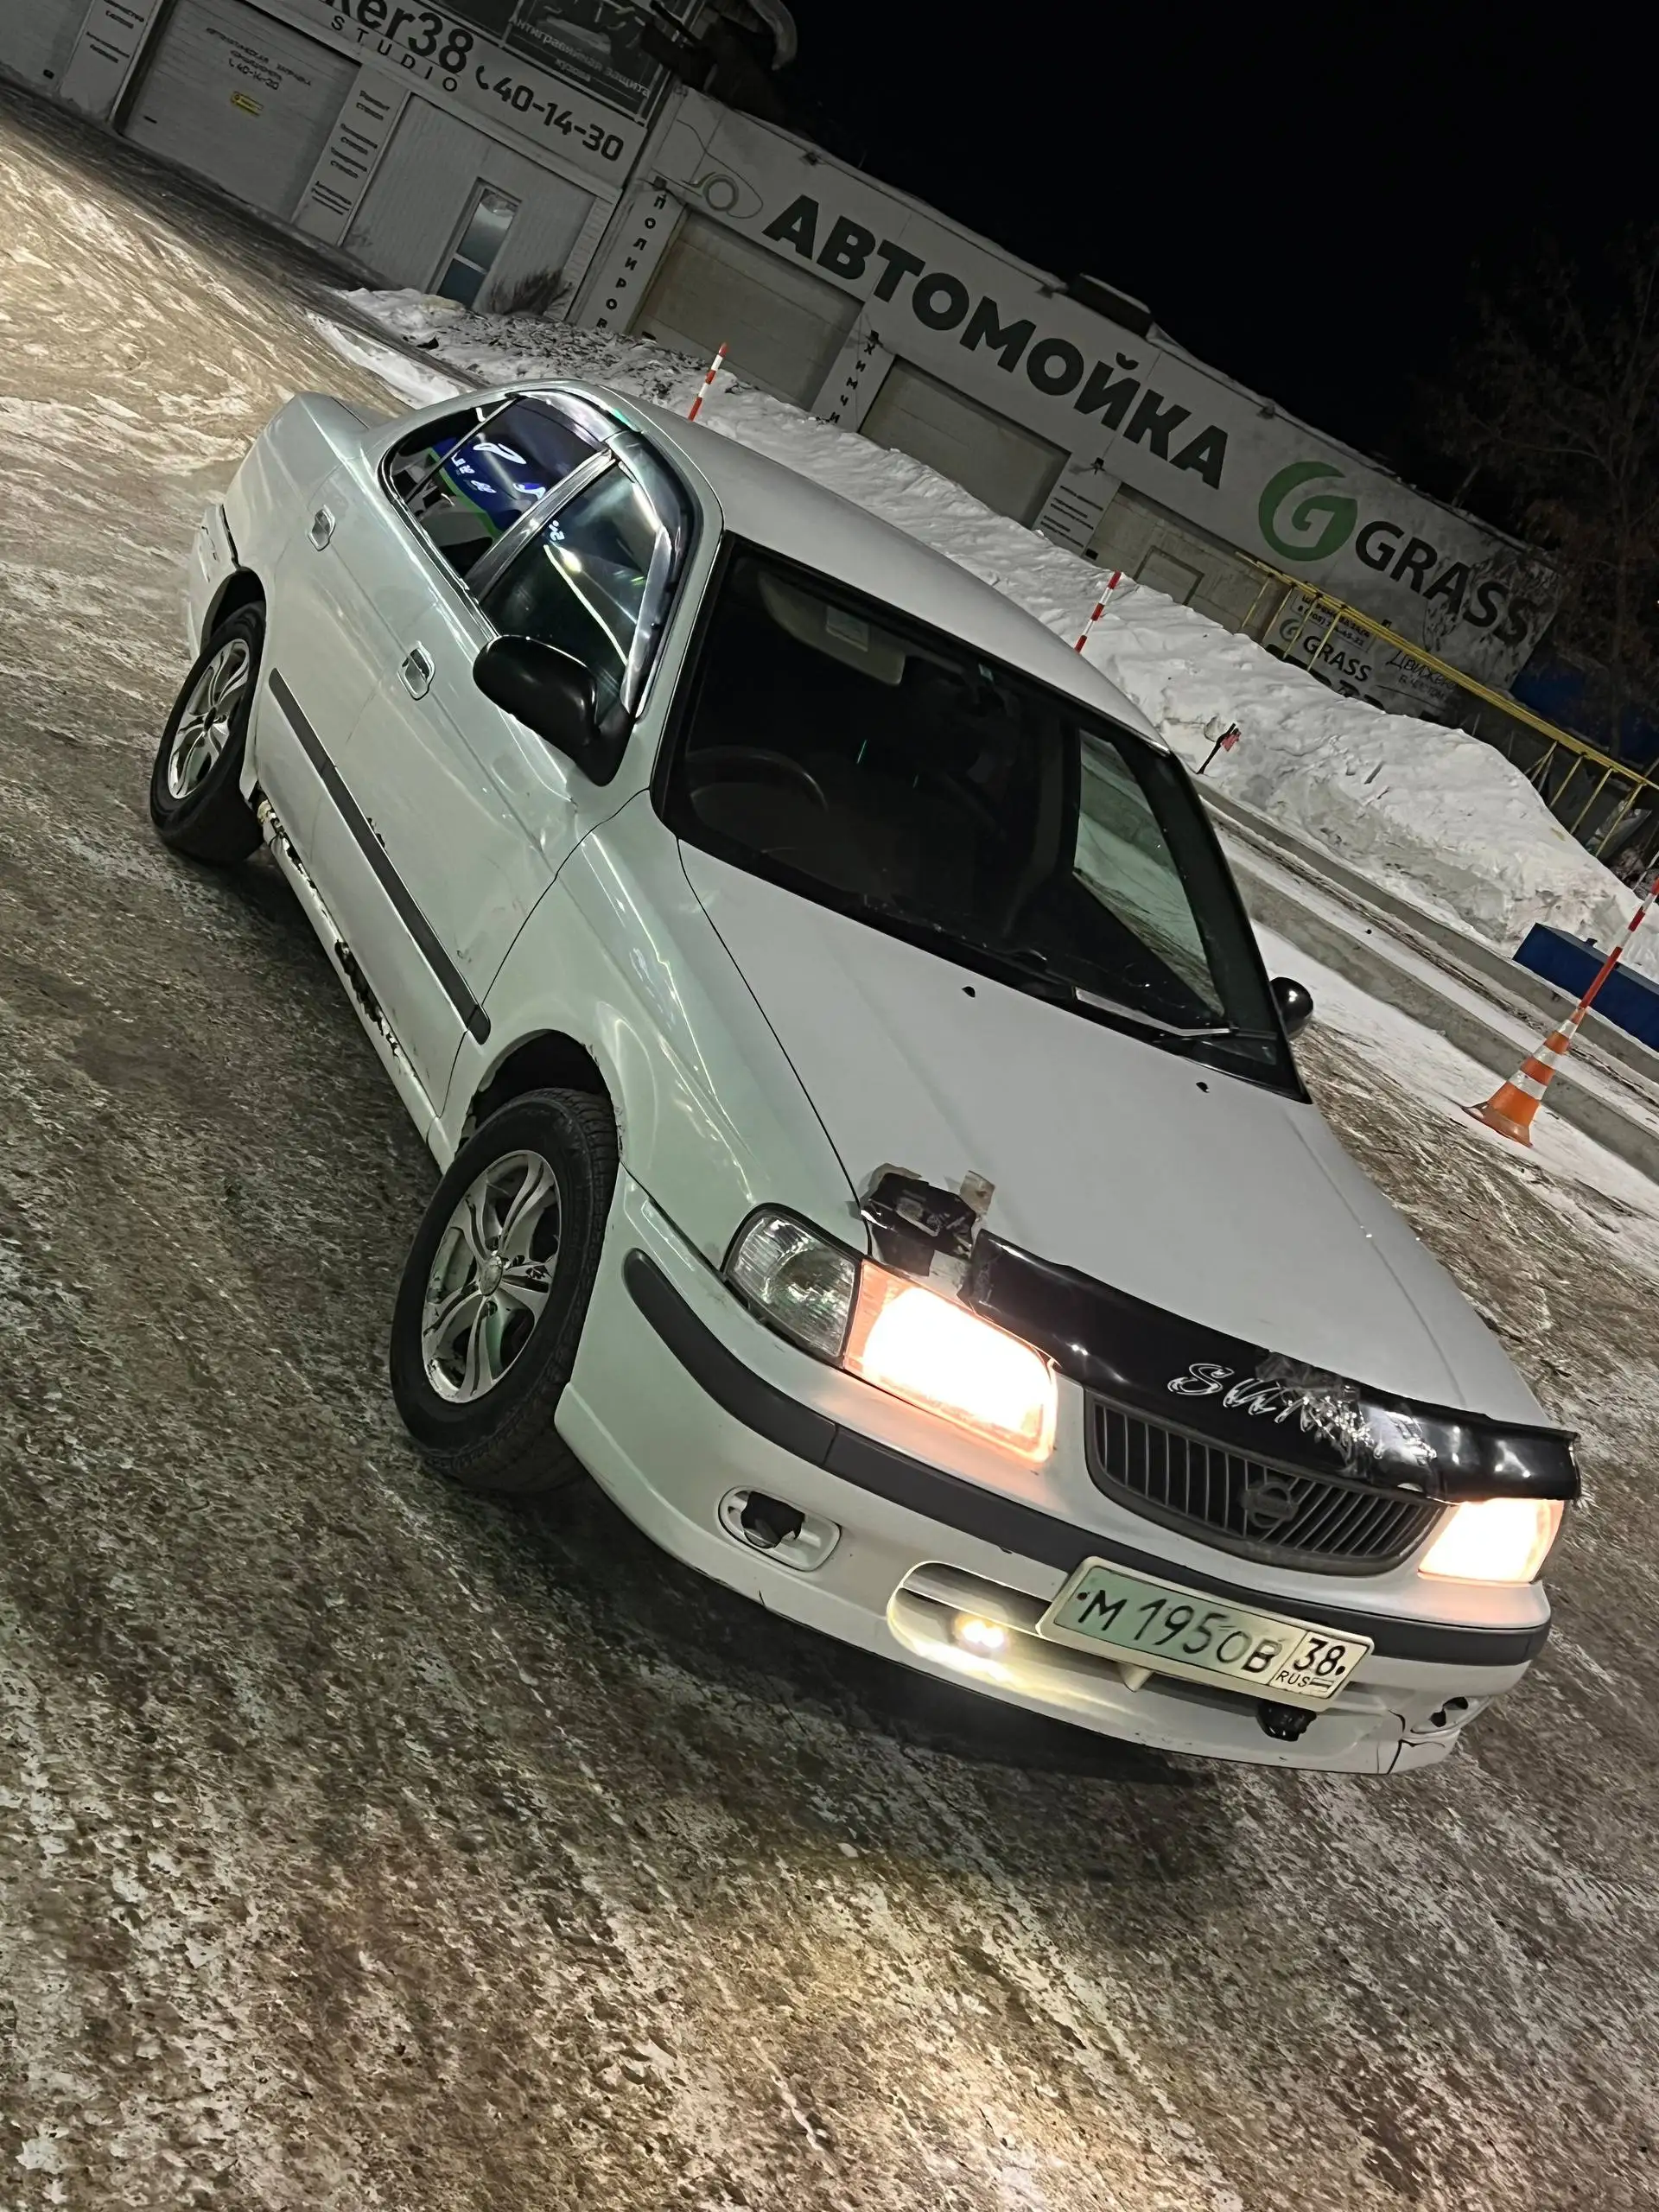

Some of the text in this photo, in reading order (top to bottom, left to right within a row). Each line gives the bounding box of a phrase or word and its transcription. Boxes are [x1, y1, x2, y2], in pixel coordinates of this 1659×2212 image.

[331, 15, 458, 92] STUDIO
[604, 66, 650, 99] защита
[493, 77, 625, 162] 40-14-30
[762, 193, 1229, 490] АВТОМОЙКА
[1354, 520, 1529, 646] GRASS
[1303, 635, 1372, 682] GRASS
[1275, 1669, 1312, 1688] RUS
[1293, 1637, 1346, 1677] 38
